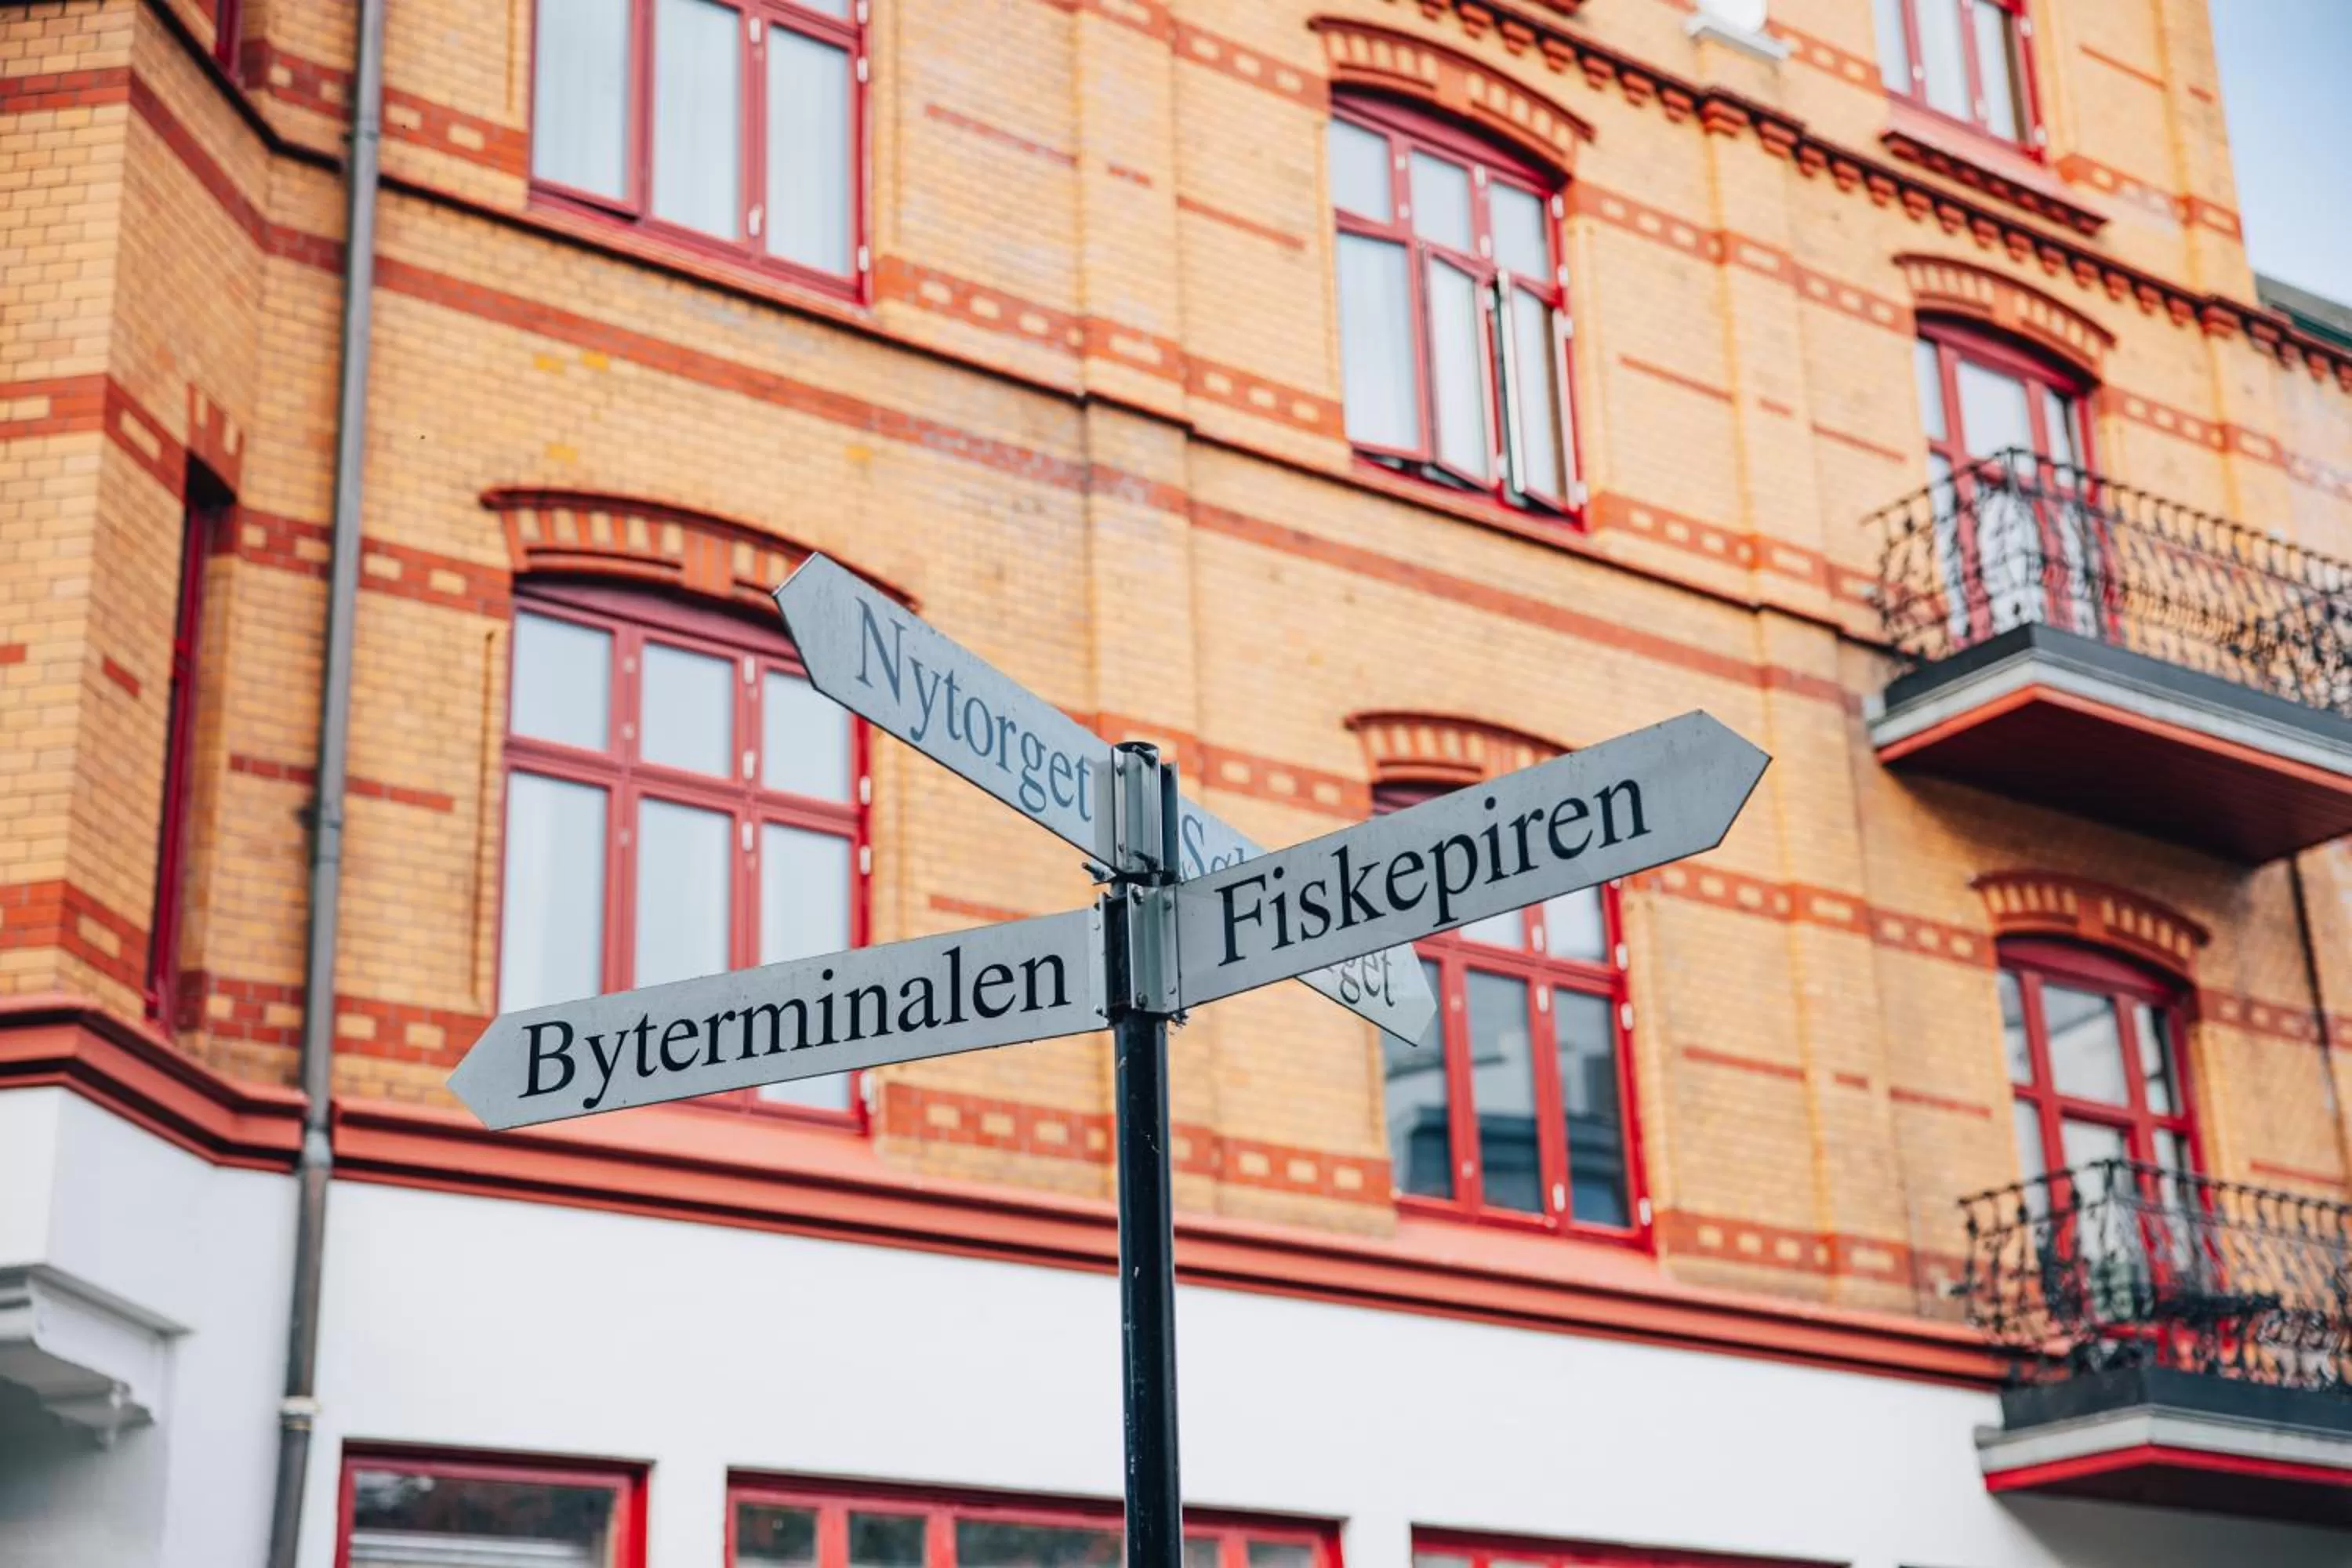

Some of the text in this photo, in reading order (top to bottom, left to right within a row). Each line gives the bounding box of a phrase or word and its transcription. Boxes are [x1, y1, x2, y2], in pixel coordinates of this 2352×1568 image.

[855, 596, 1092, 822] Nytorget
[1214, 777, 1651, 967] Fiskepiren
[517, 946, 1073, 1109] Byterminalen
